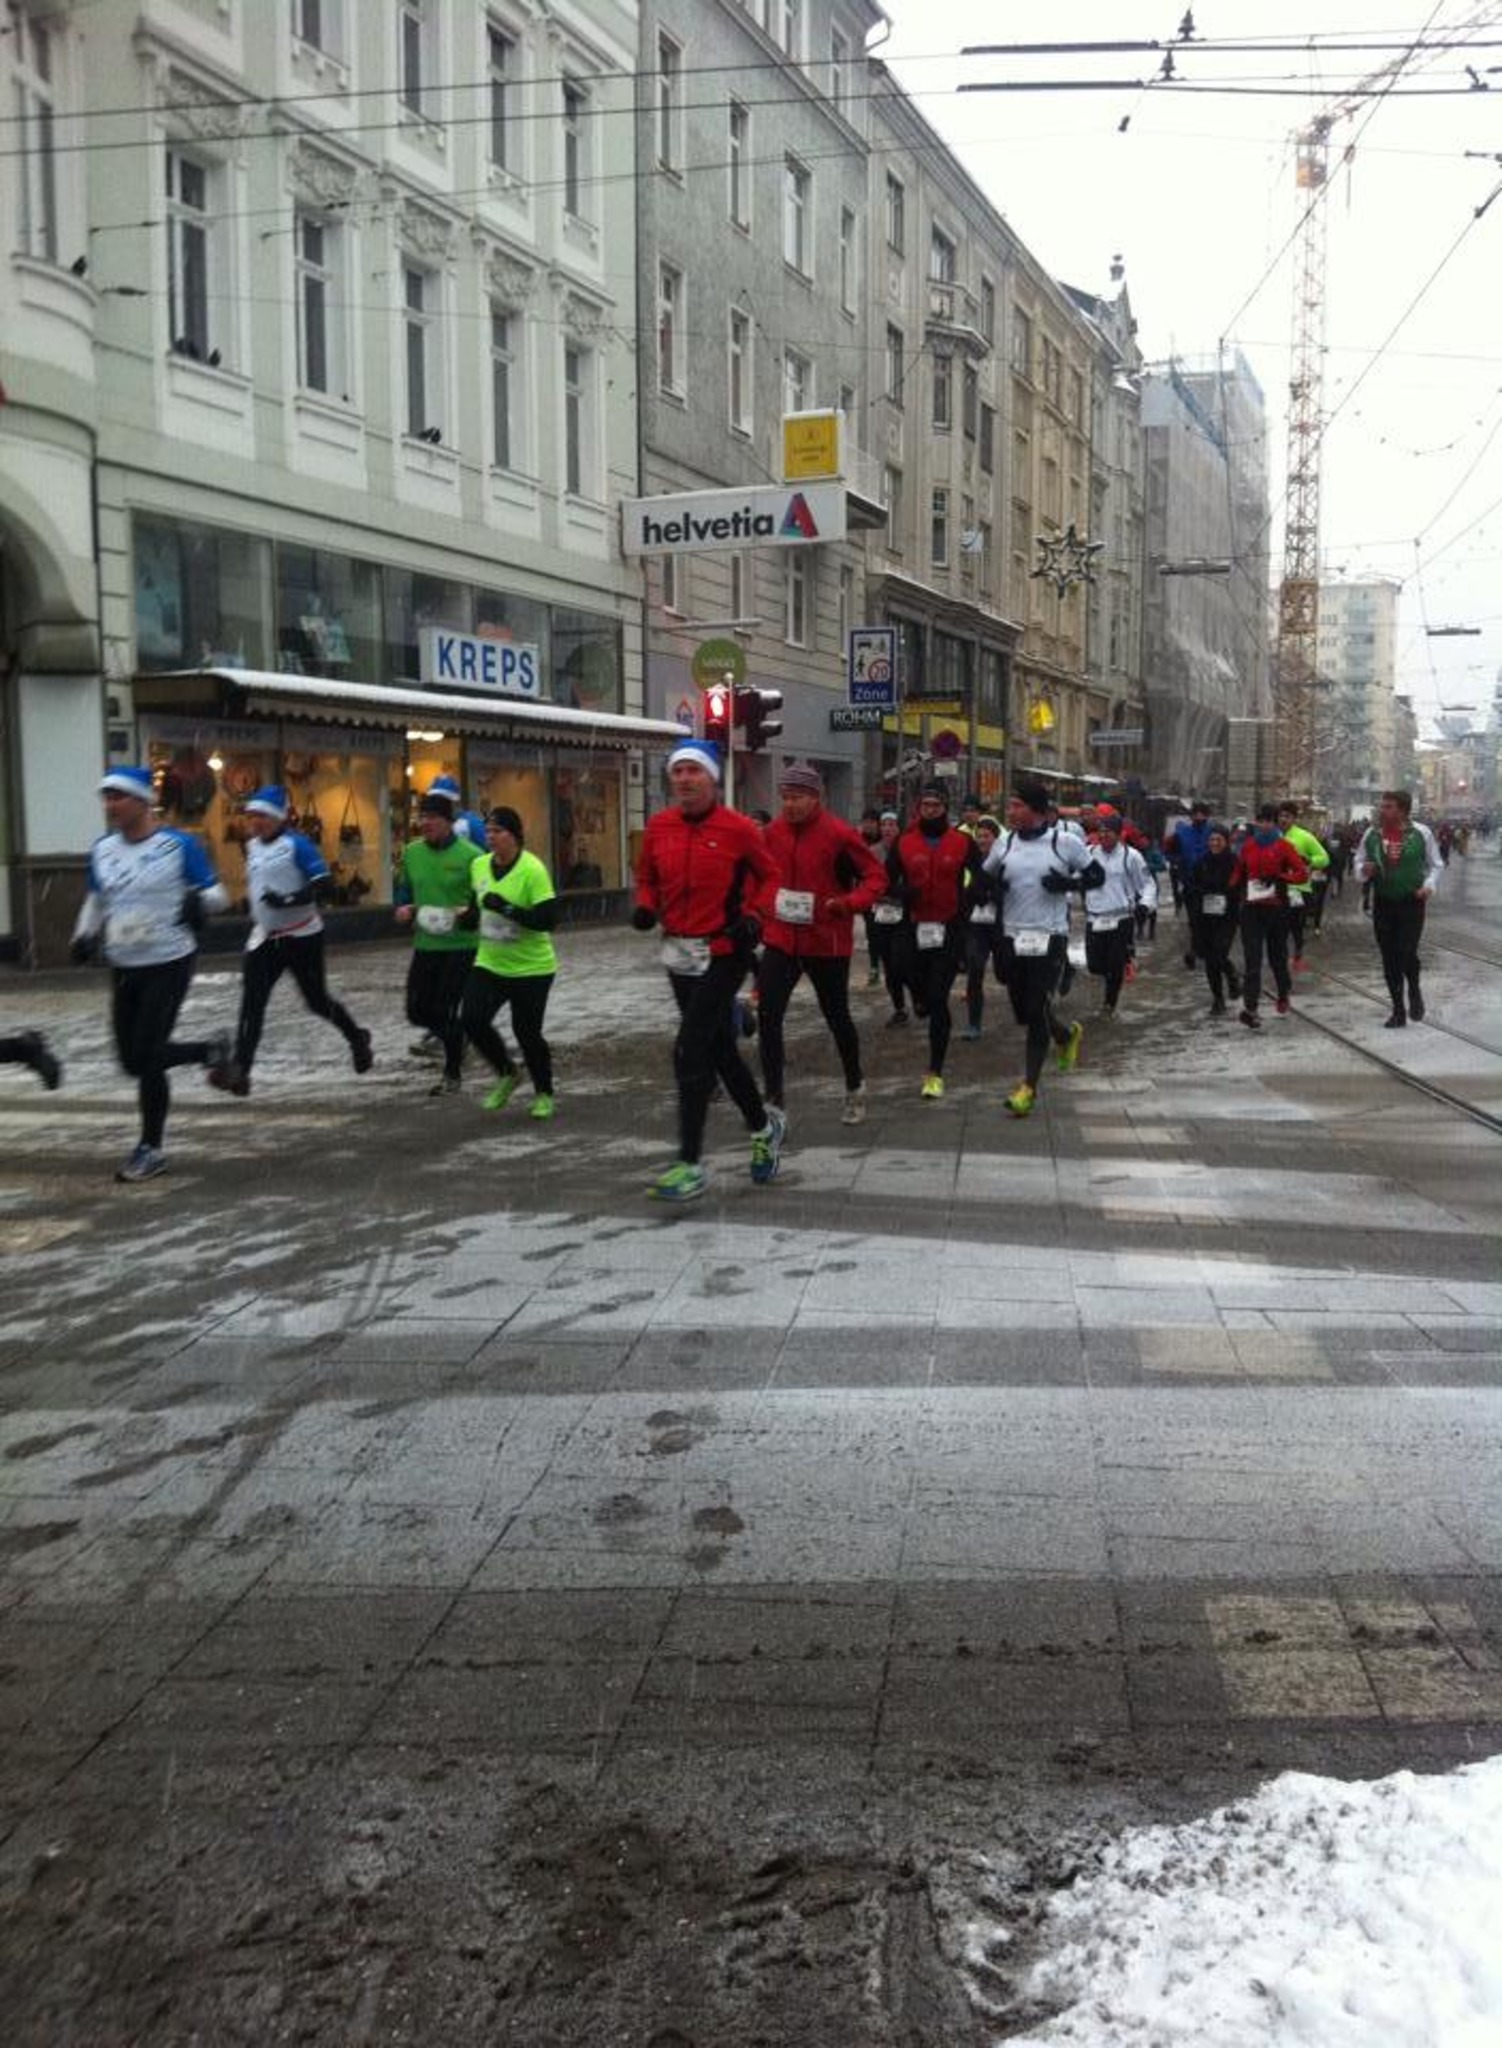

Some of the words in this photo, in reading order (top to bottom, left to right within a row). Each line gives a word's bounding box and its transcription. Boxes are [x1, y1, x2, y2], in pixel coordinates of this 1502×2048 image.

[642, 505, 774, 545] helvetia
[438, 635, 534, 690] KREPS
[855, 688, 889, 701] Zone
